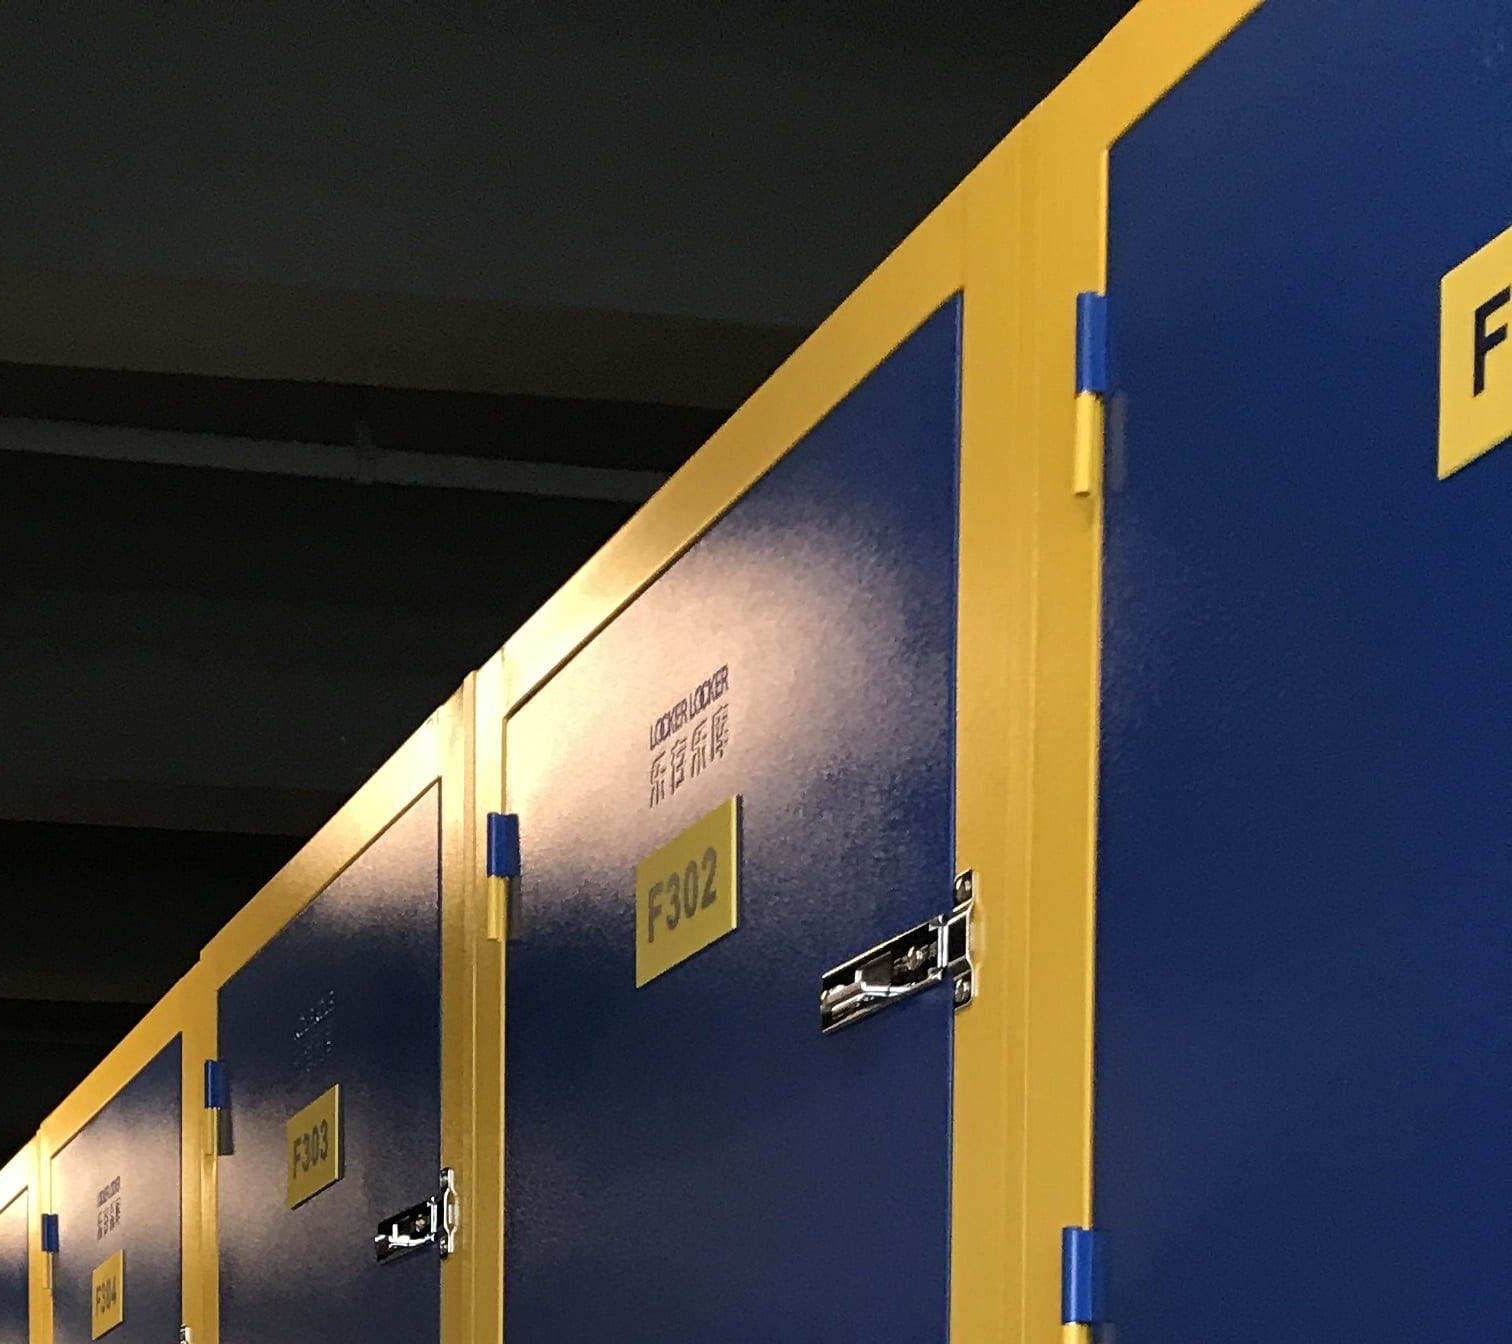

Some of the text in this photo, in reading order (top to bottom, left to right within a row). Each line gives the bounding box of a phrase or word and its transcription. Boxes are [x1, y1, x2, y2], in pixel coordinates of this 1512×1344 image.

[649, 662, 729, 751] LOCKER LOCKER
[647, 846, 717, 943] F302
[292, 1118, 329, 1180] F303
